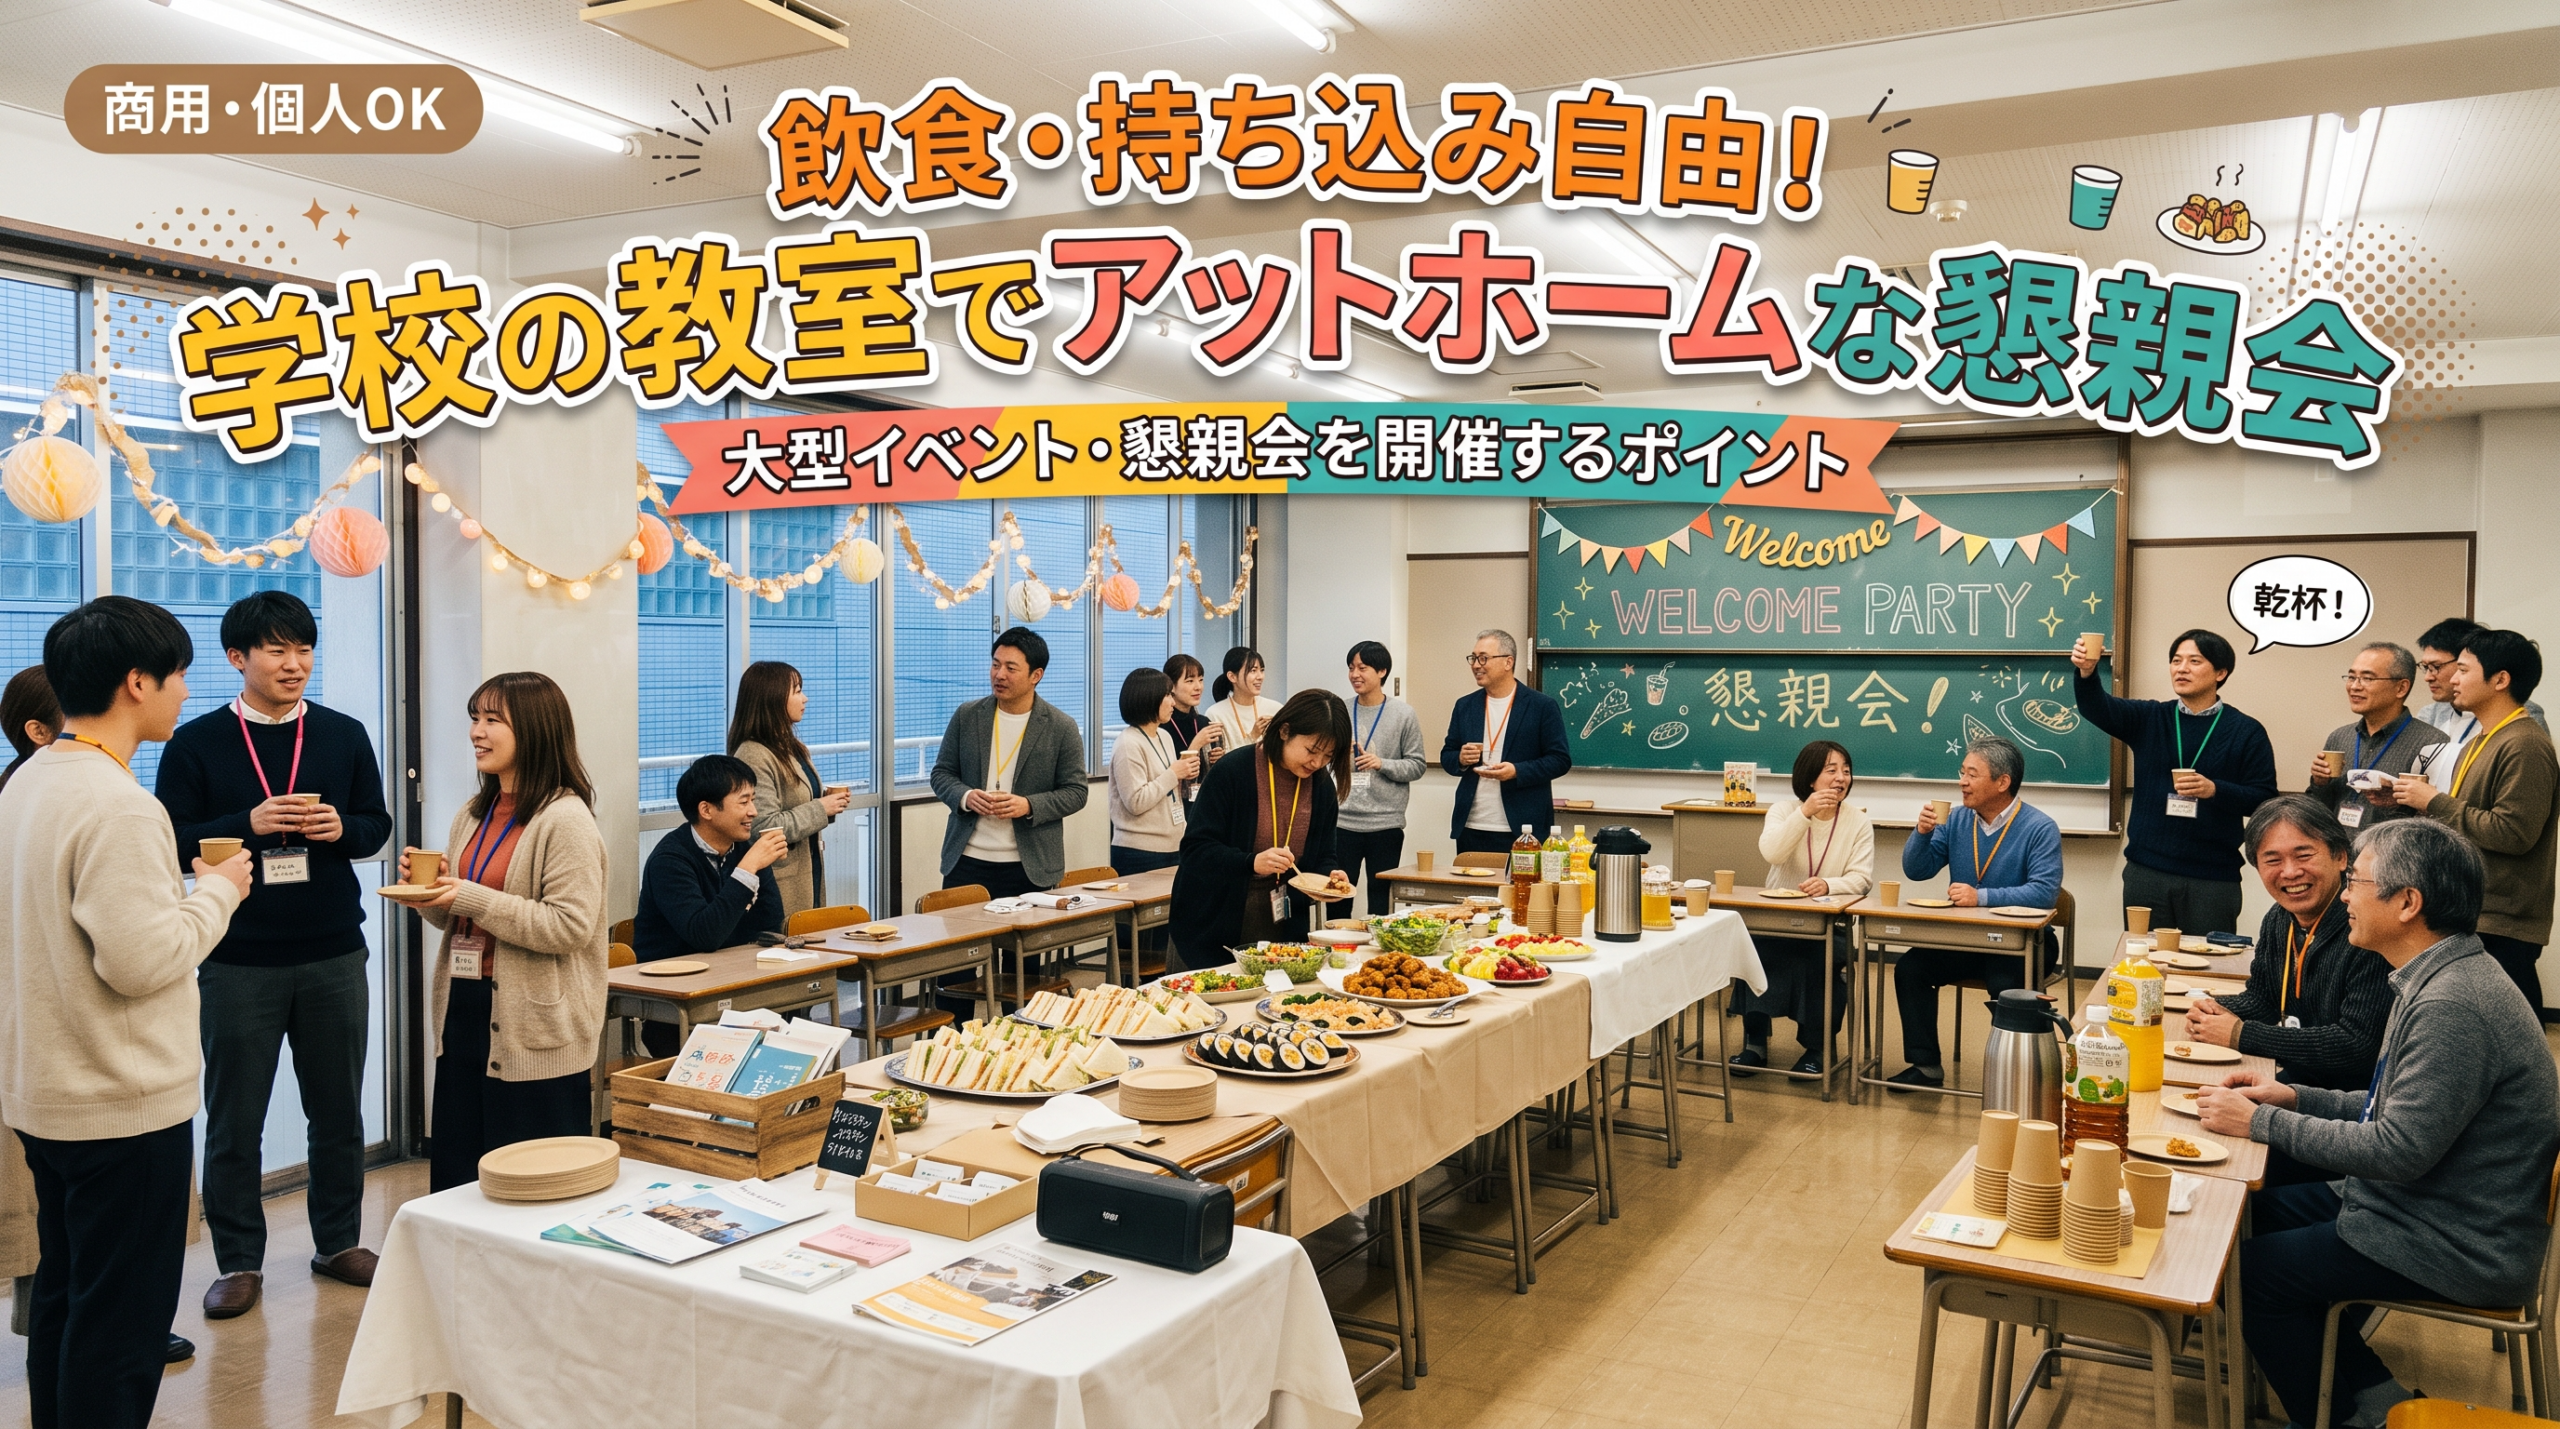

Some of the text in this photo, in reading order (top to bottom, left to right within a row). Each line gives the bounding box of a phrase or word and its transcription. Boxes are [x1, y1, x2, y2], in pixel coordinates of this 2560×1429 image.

[1723, 514, 1892, 568] Welcome
[1611, 582, 2032, 638] WELCOME PARTY
[1704, 667, 1950, 734] 懇親会！
